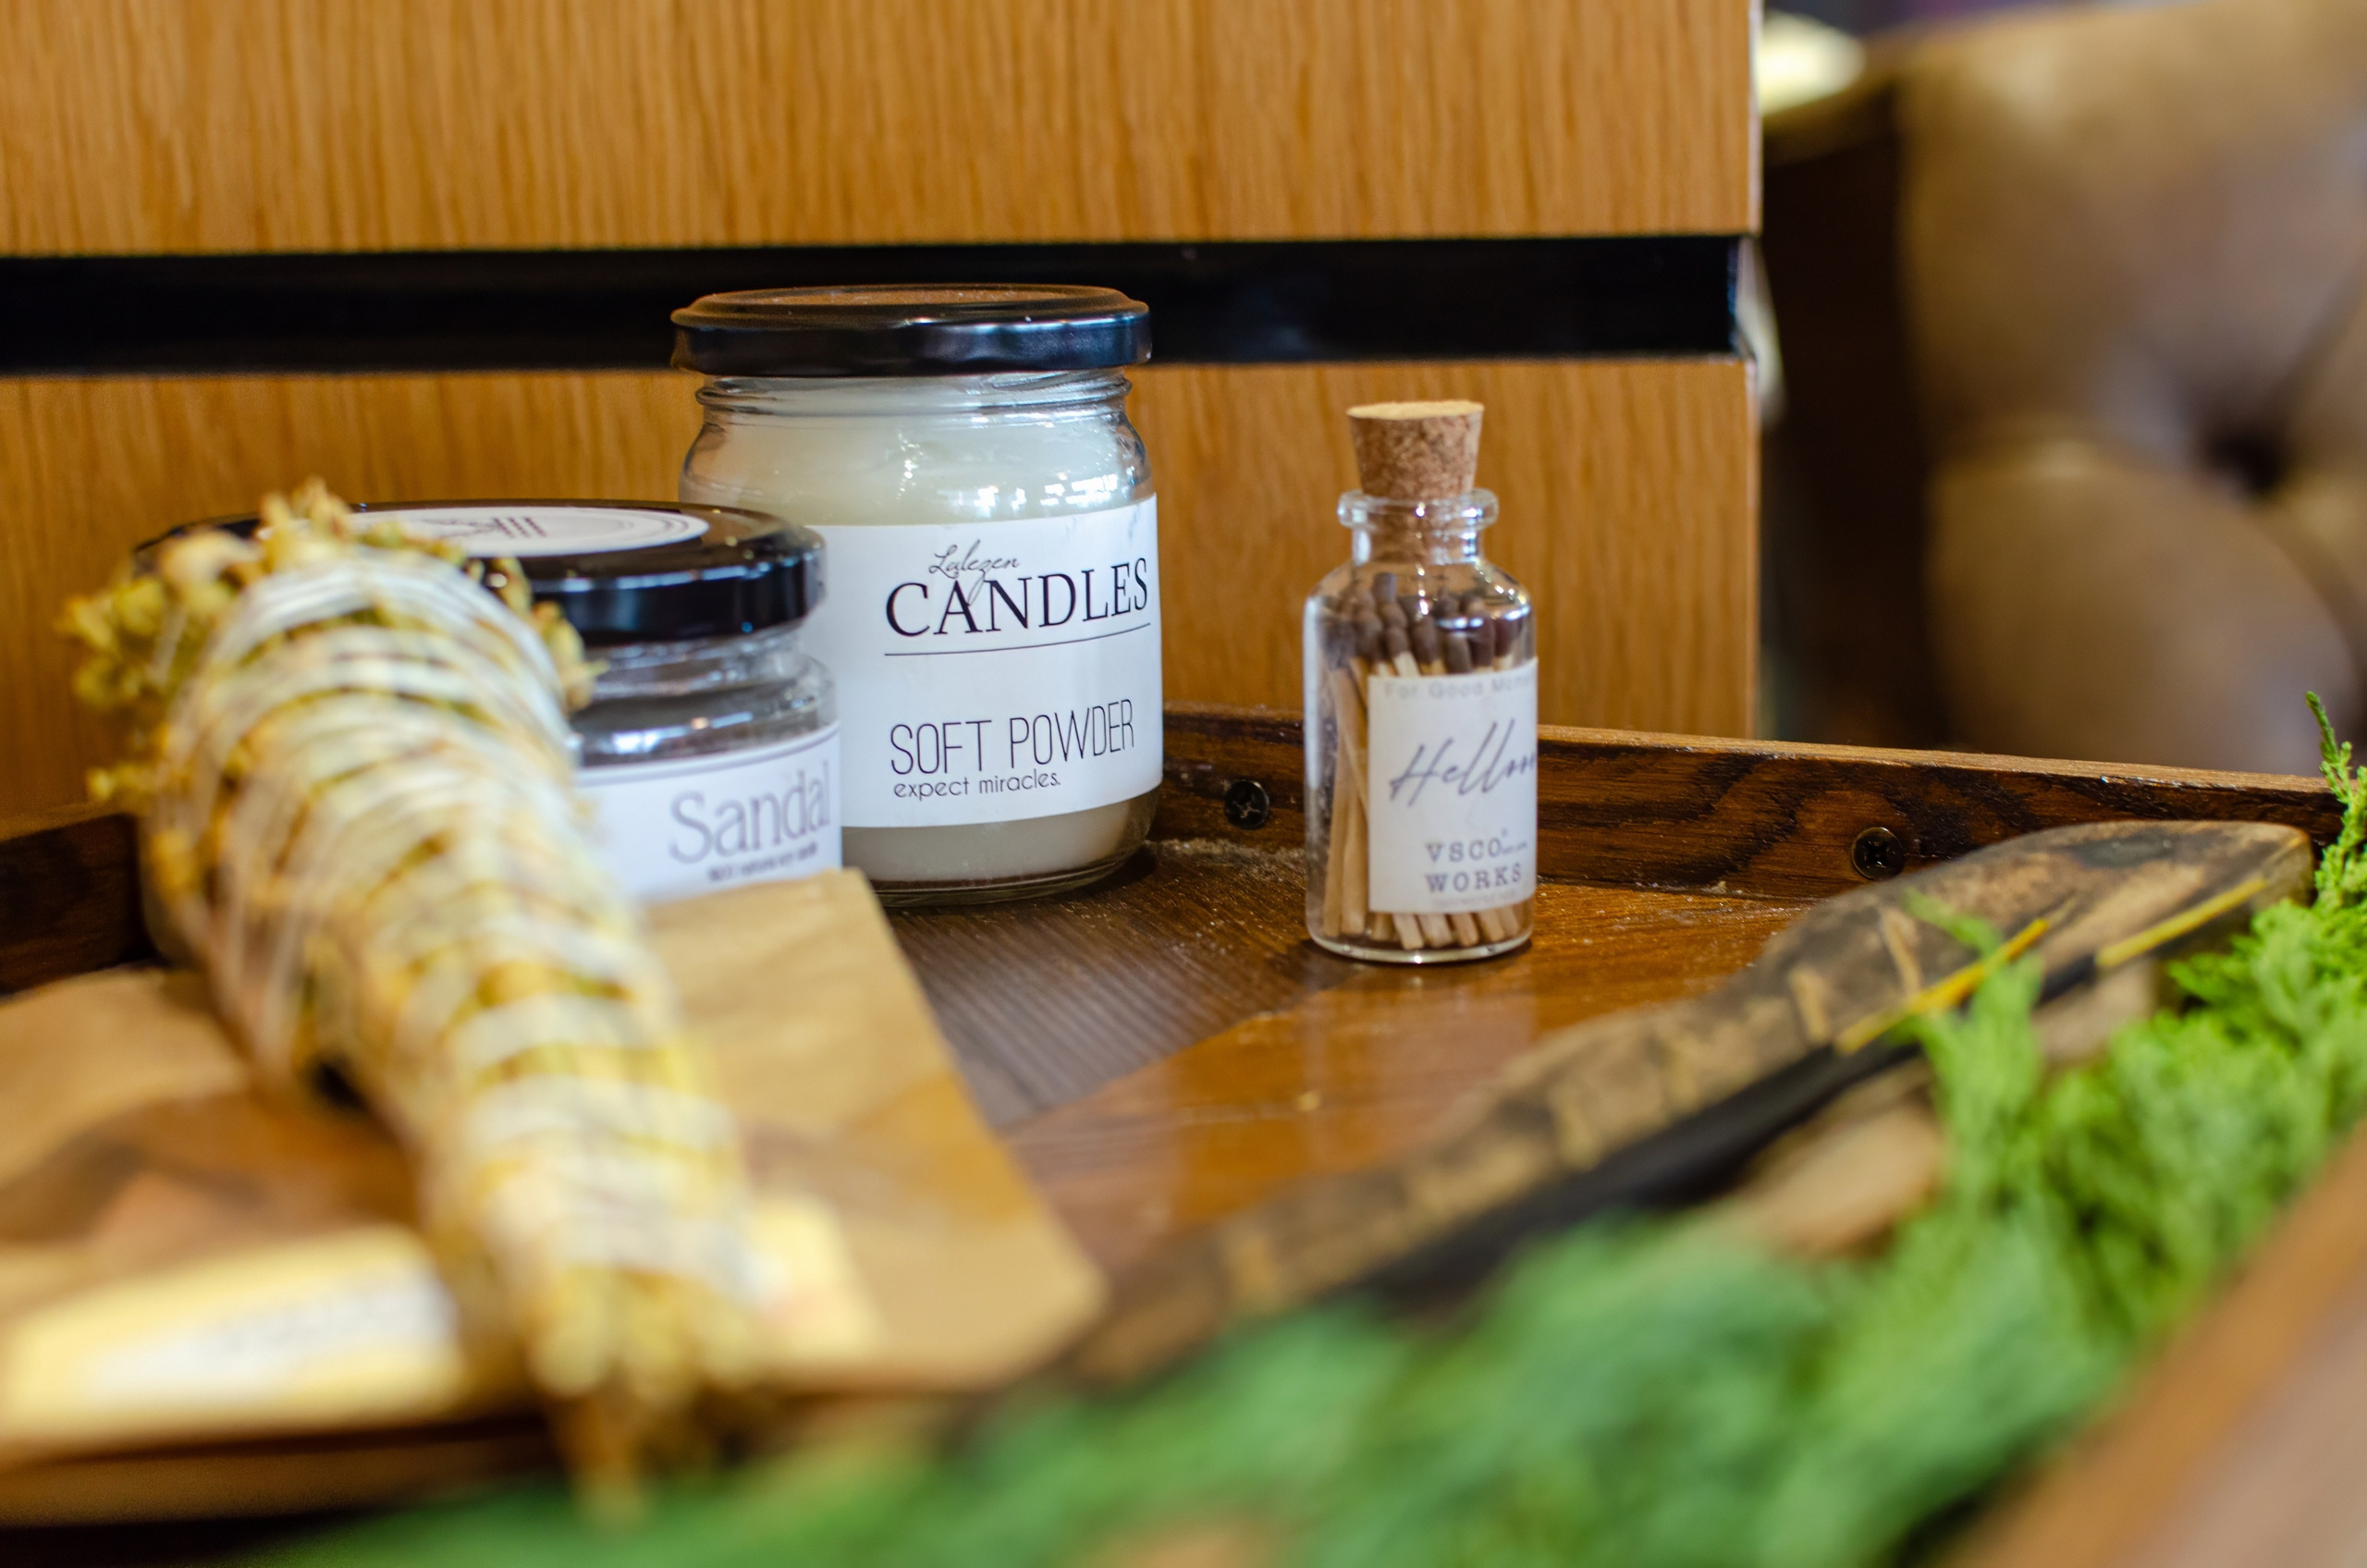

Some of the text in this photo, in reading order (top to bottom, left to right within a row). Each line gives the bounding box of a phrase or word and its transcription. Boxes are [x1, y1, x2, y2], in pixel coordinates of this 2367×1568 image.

[885, 557, 1147, 638] CANDLES
[889, 698, 1134, 775] SOFT POWDER
[668, 759, 831, 864] Sandal
[893, 777, 970, 802] expect
[1424, 862, 1522, 894] WORKS
